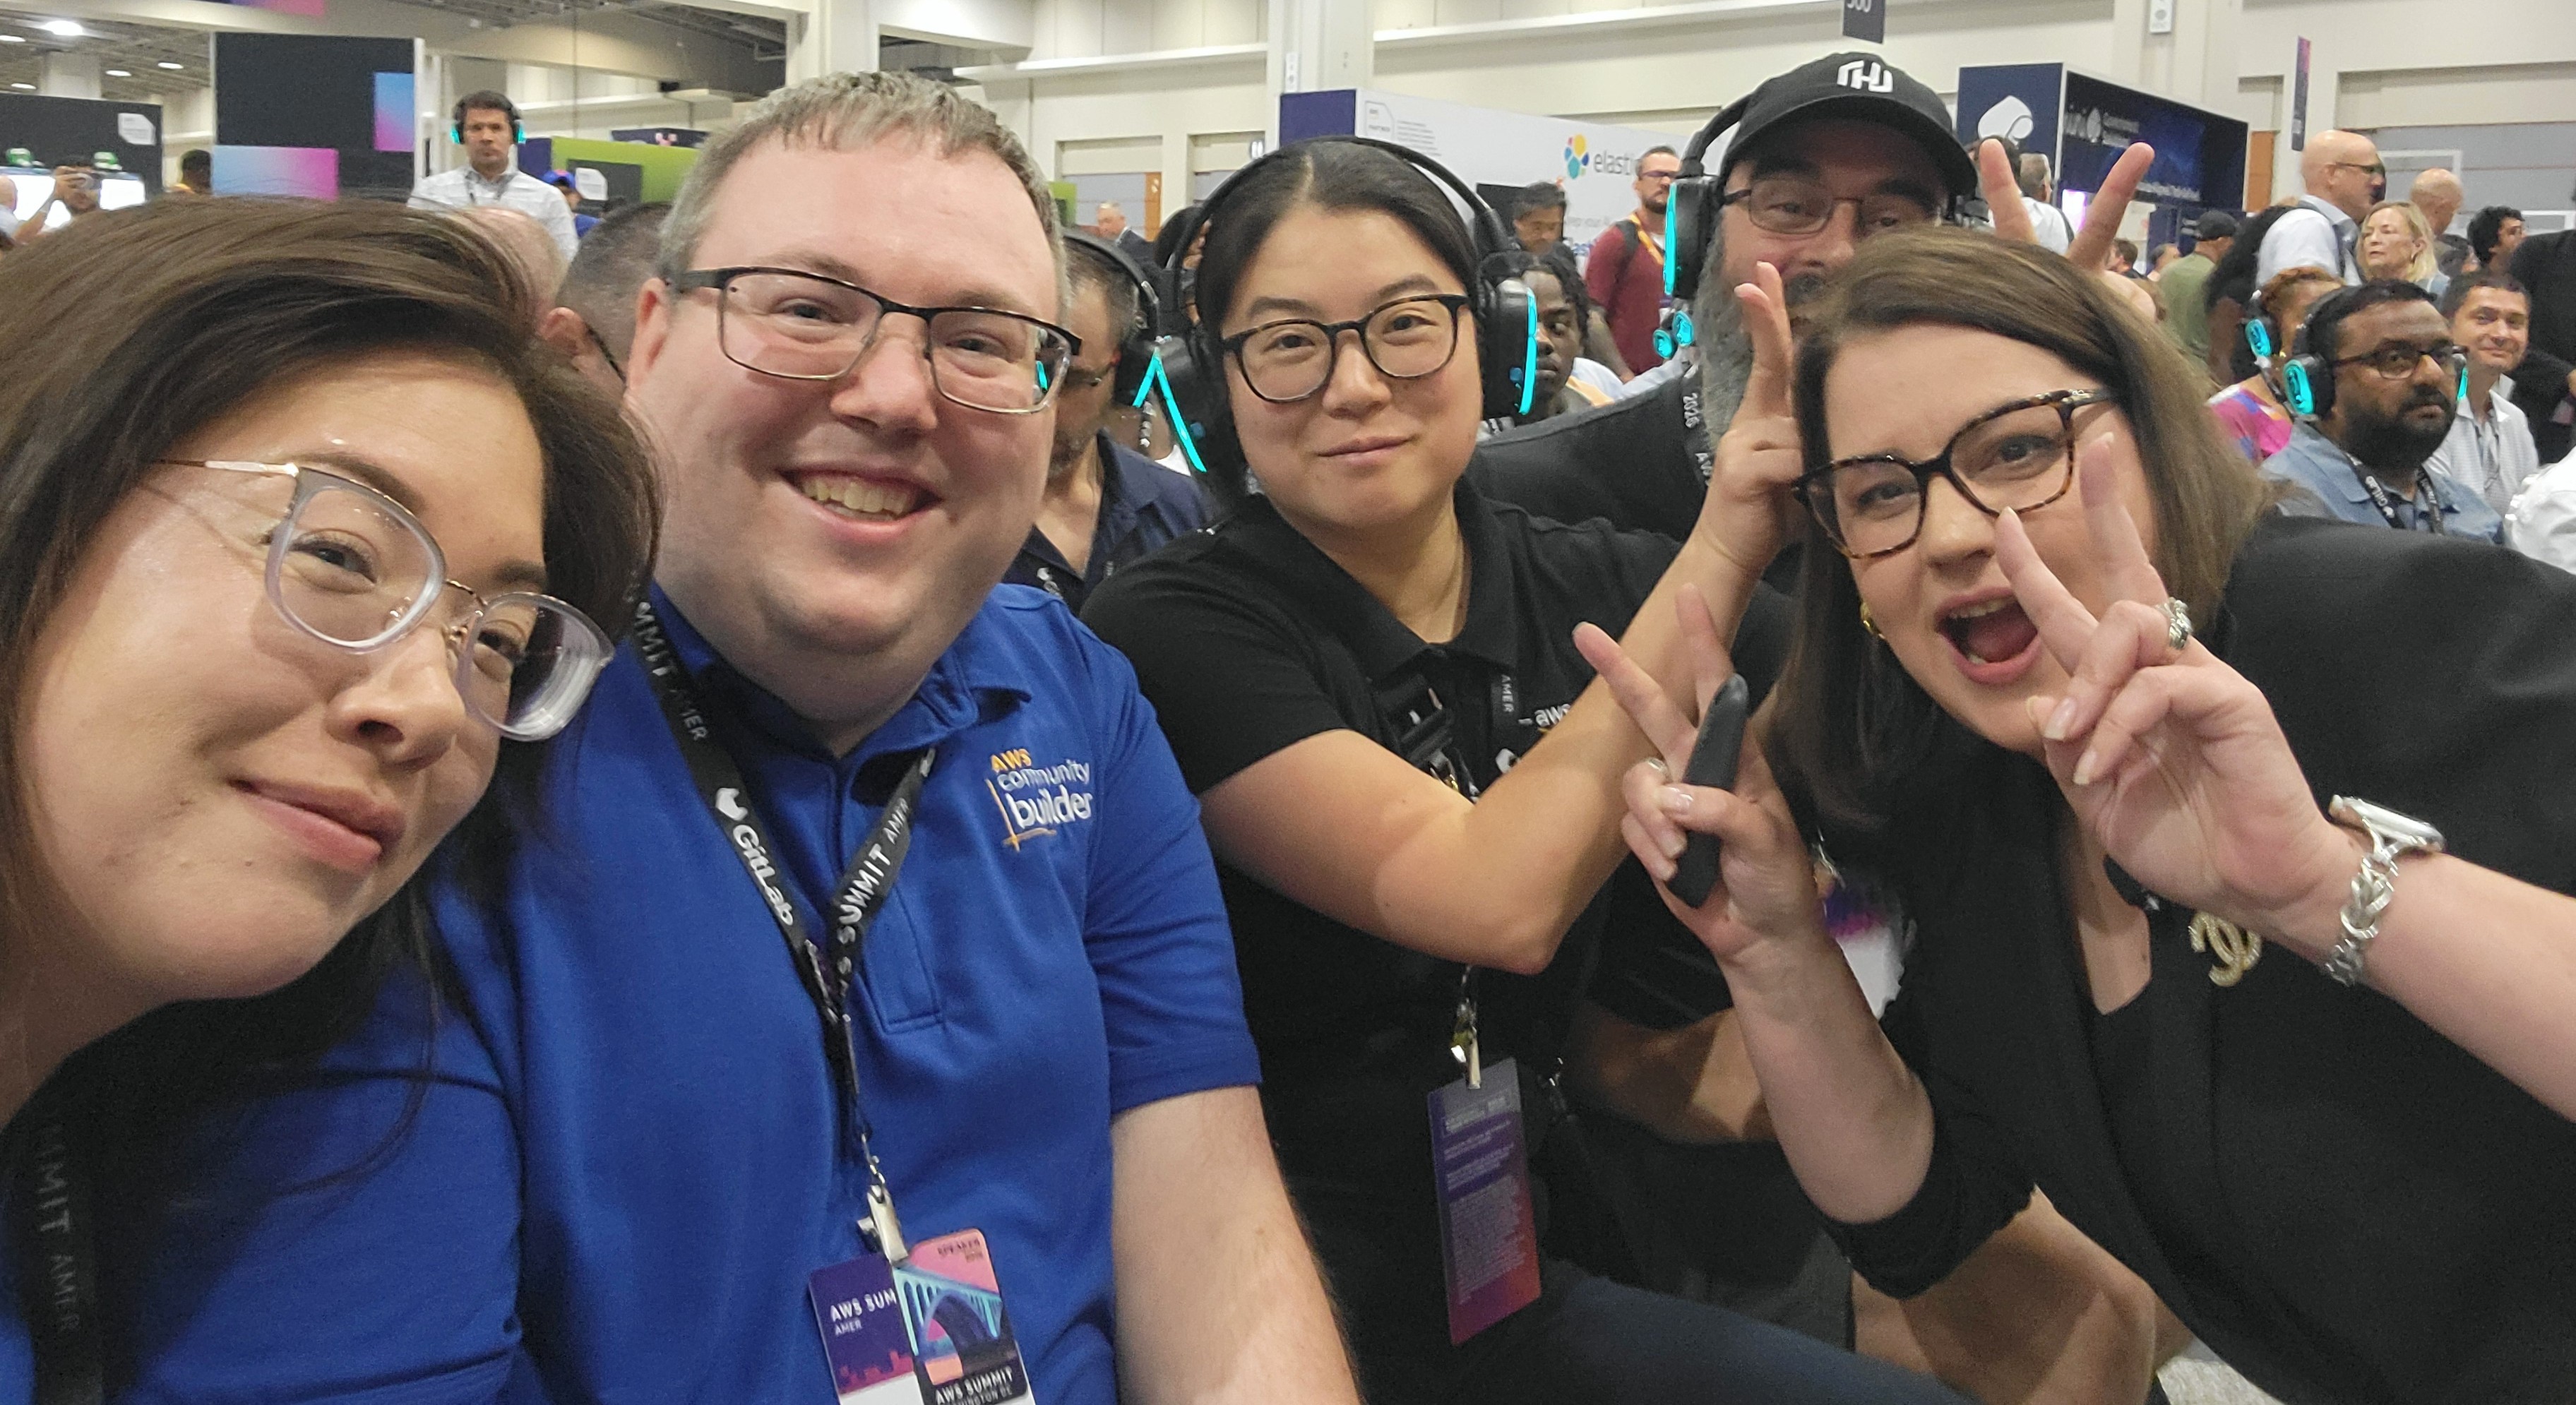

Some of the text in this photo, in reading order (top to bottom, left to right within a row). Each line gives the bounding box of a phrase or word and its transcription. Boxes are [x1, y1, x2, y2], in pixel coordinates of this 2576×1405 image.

[1593, 149, 1639, 175] elasti
[1501, 674, 1515, 713] AMER
[990, 748, 1032, 775] AWS
[996, 758, 1090, 791] community
[1004, 784, 1094, 830] builder
[732, 823, 794, 926] GitLab
[837, 843, 891, 945] SUMMIT
[830, 1287, 898, 1322] AWS SUM
[936, 1365, 1013, 1405] AWS SUMMIT
